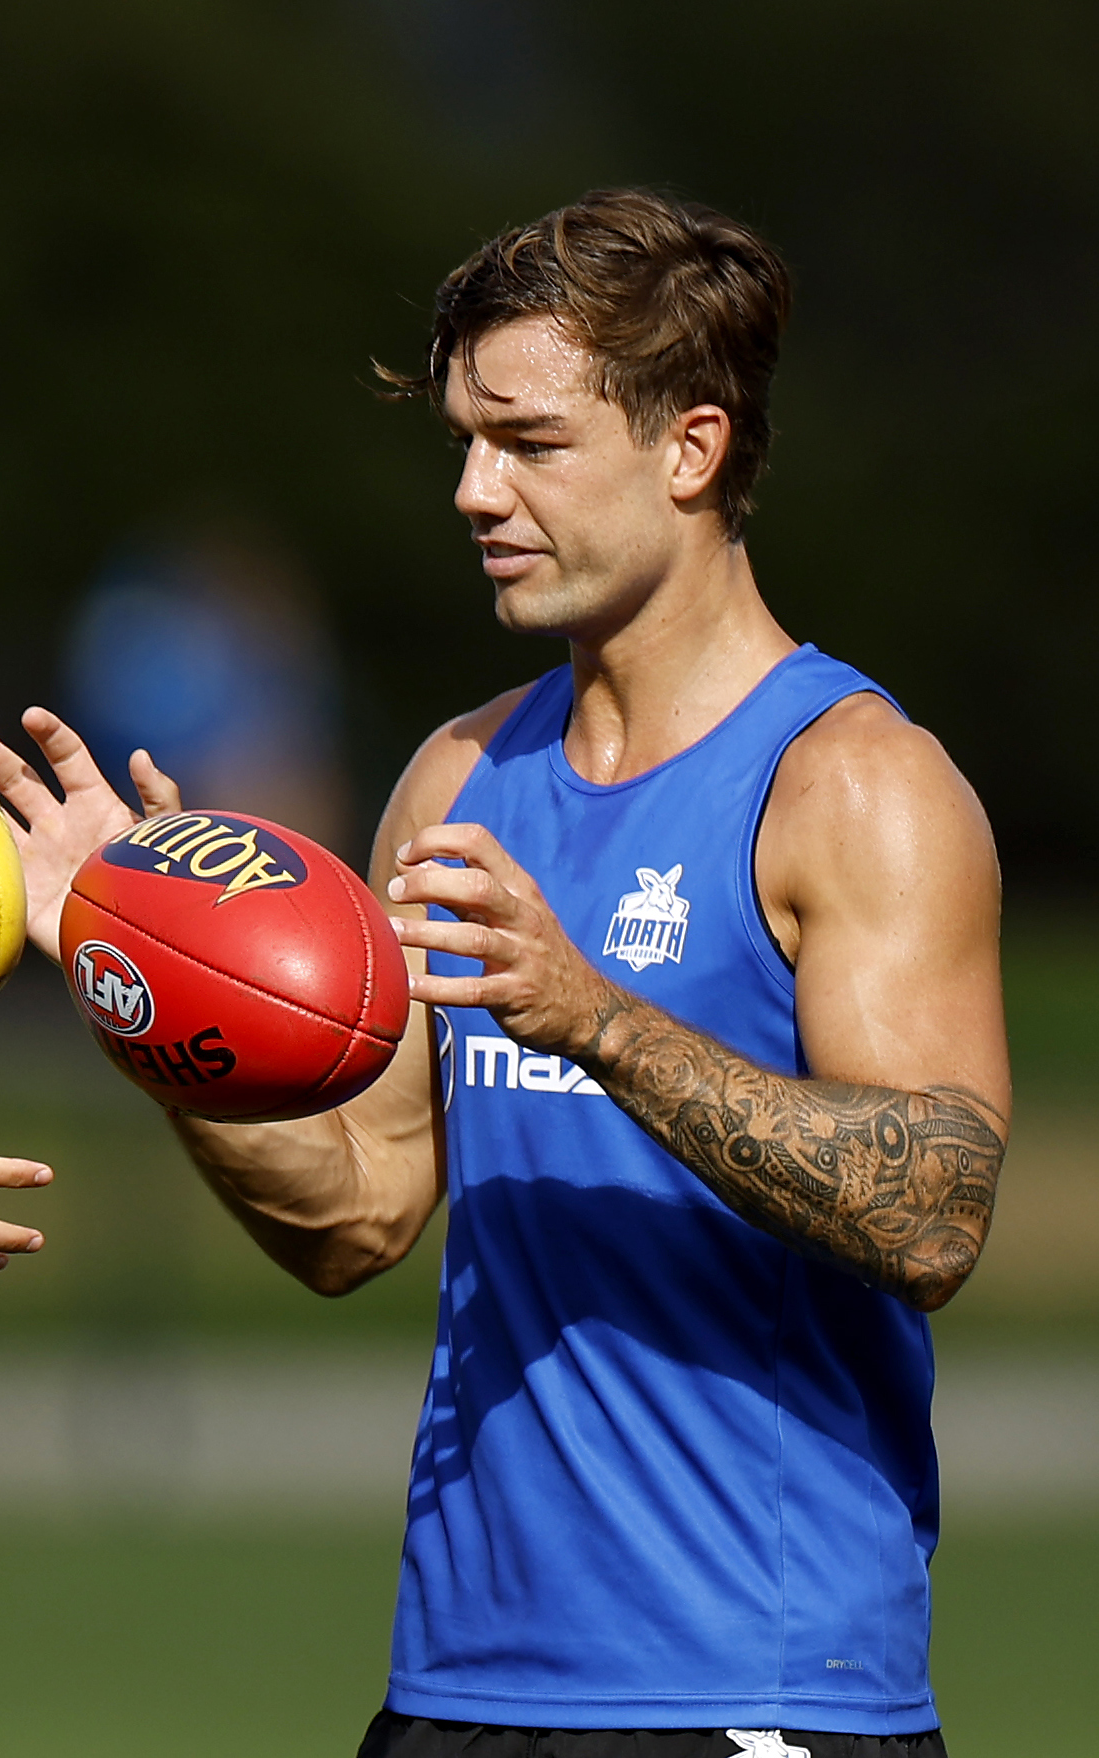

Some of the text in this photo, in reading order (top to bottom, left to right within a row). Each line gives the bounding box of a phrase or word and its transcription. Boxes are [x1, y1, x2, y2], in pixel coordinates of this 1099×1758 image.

[606, 916, 685, 960] NORTH
[78, 950, 144, 1022] AFL
[826, 1658, 864, 1670] DRYCELL
